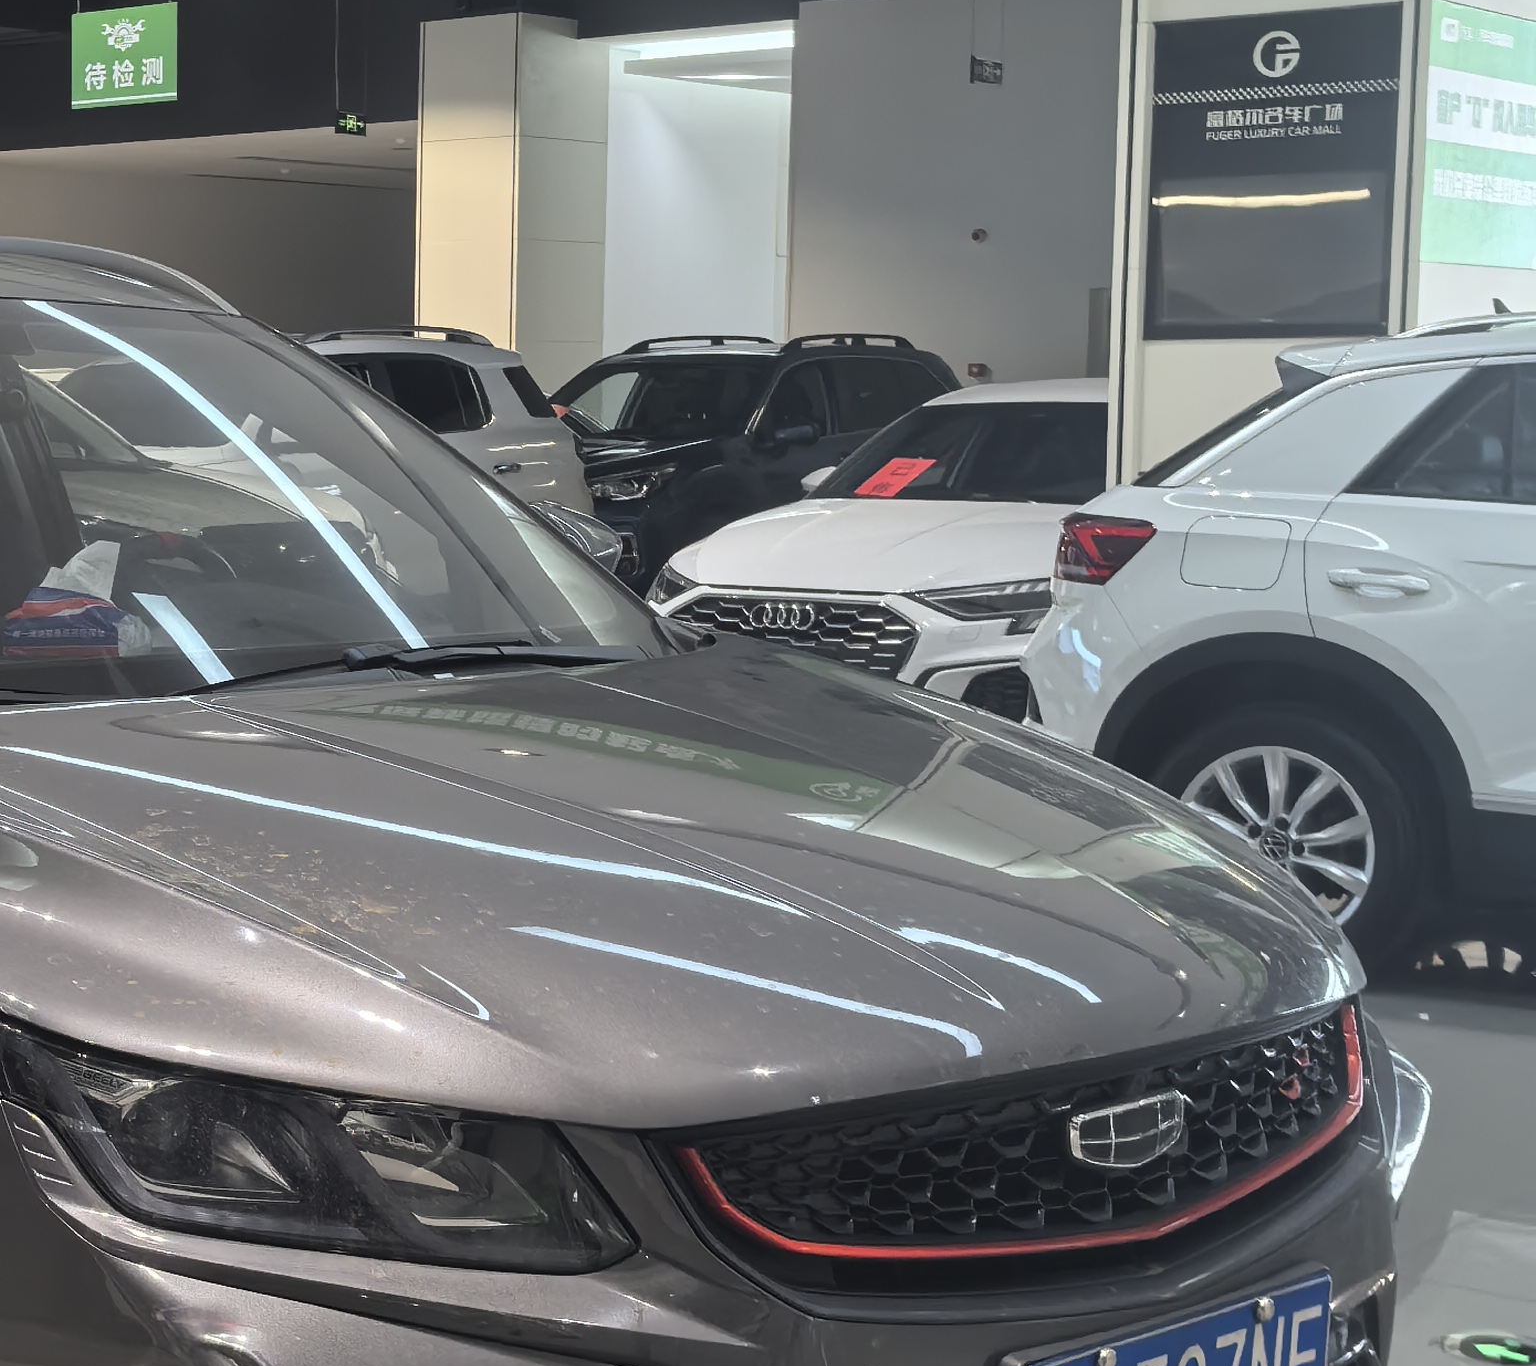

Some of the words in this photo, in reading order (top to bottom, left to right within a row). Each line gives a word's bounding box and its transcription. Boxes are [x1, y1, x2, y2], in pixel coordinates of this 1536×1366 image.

[84, 55, 164, 92] 待检测
[1287, 125, 1310, 137] CAR
